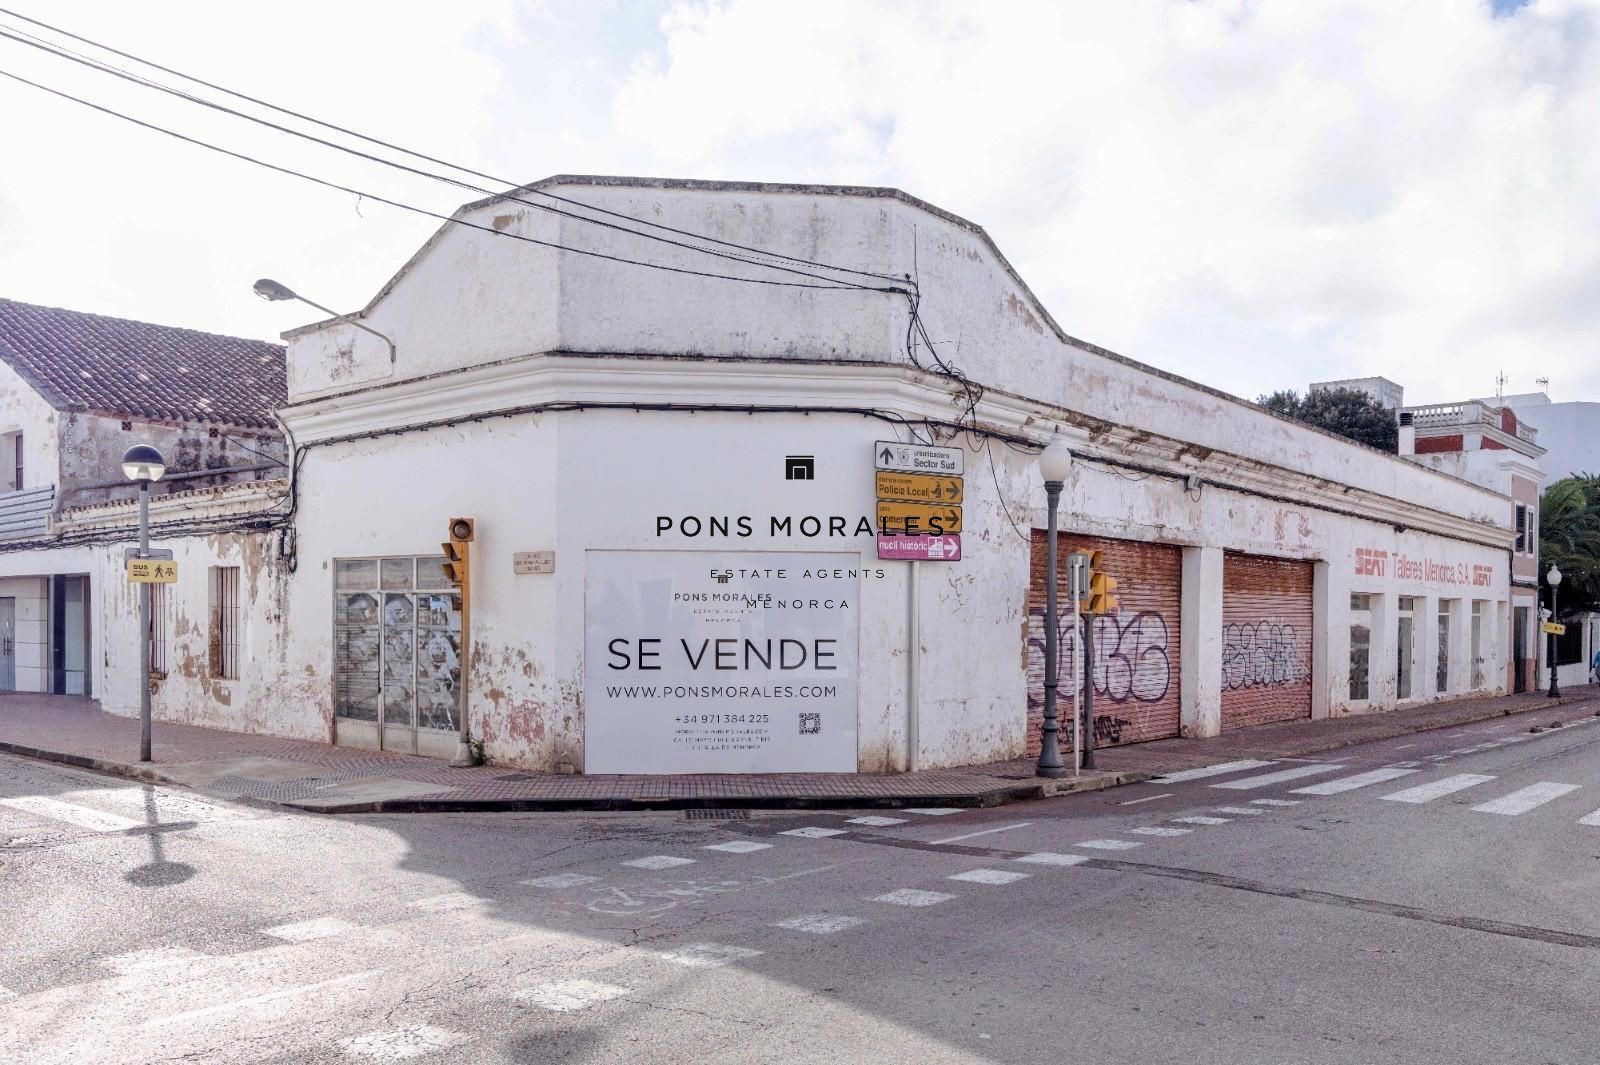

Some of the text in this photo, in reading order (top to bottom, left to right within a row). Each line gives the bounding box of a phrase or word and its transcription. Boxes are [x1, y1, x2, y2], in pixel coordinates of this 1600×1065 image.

[913, 458, 955, 470] Sector Sud
[907, 486, 929, 497] Local
[879, 540, 898, 550] nucli
[1354, 547, 1388, 577] SEAT
[1391, 552, 1423, 581] Talleres
[1472, 564, 1493, 587] SEAT
[674, 593, 772, 602] PONS MORALES
[607, 638, 838, 671] SE VENDE
[606, 686, 837, 698] WWW.PONSMORALES.COM
[674, 714, 769, 724] +34 971 384 225
